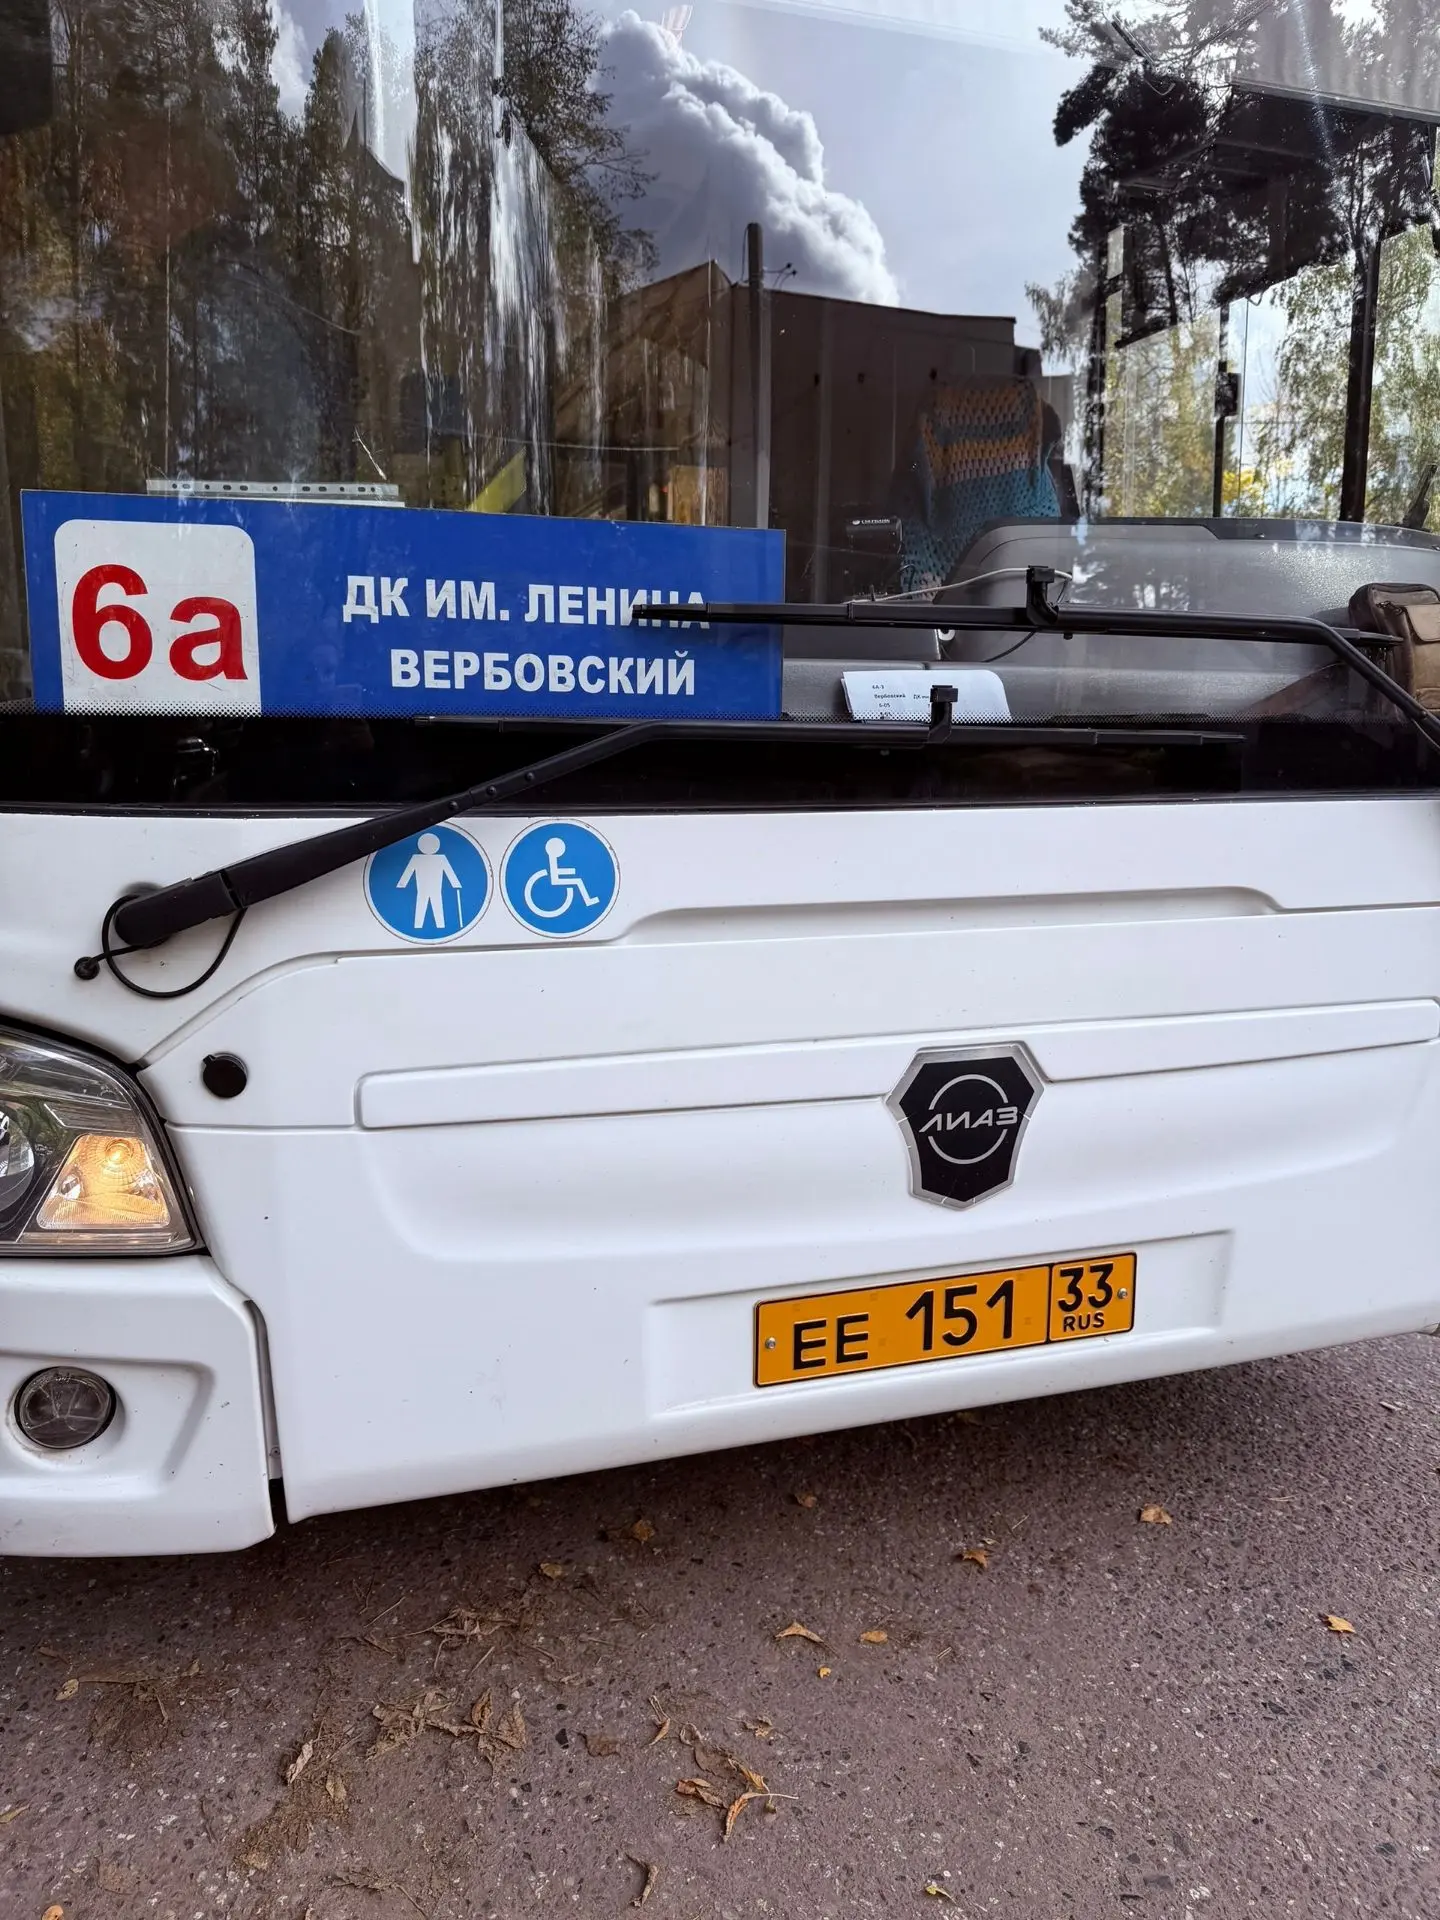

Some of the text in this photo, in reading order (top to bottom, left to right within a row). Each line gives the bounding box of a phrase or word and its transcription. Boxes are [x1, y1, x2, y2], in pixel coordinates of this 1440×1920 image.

[71, 563, 248, 681] 6а
[343, 575, 410, 624] ДК
[425, 578, 510, 621] ИМ.
[390, 648, 696, 696] ВЕРБОВСКИЙ
[918, 1105, 1018, 1134] ЛИАЗ
[1057, 1262, 1114, 1313] 33
[792, 1279, 1014, 1371] ЕЕ 151
[1062, 1311, 1106, 1333] RUS
